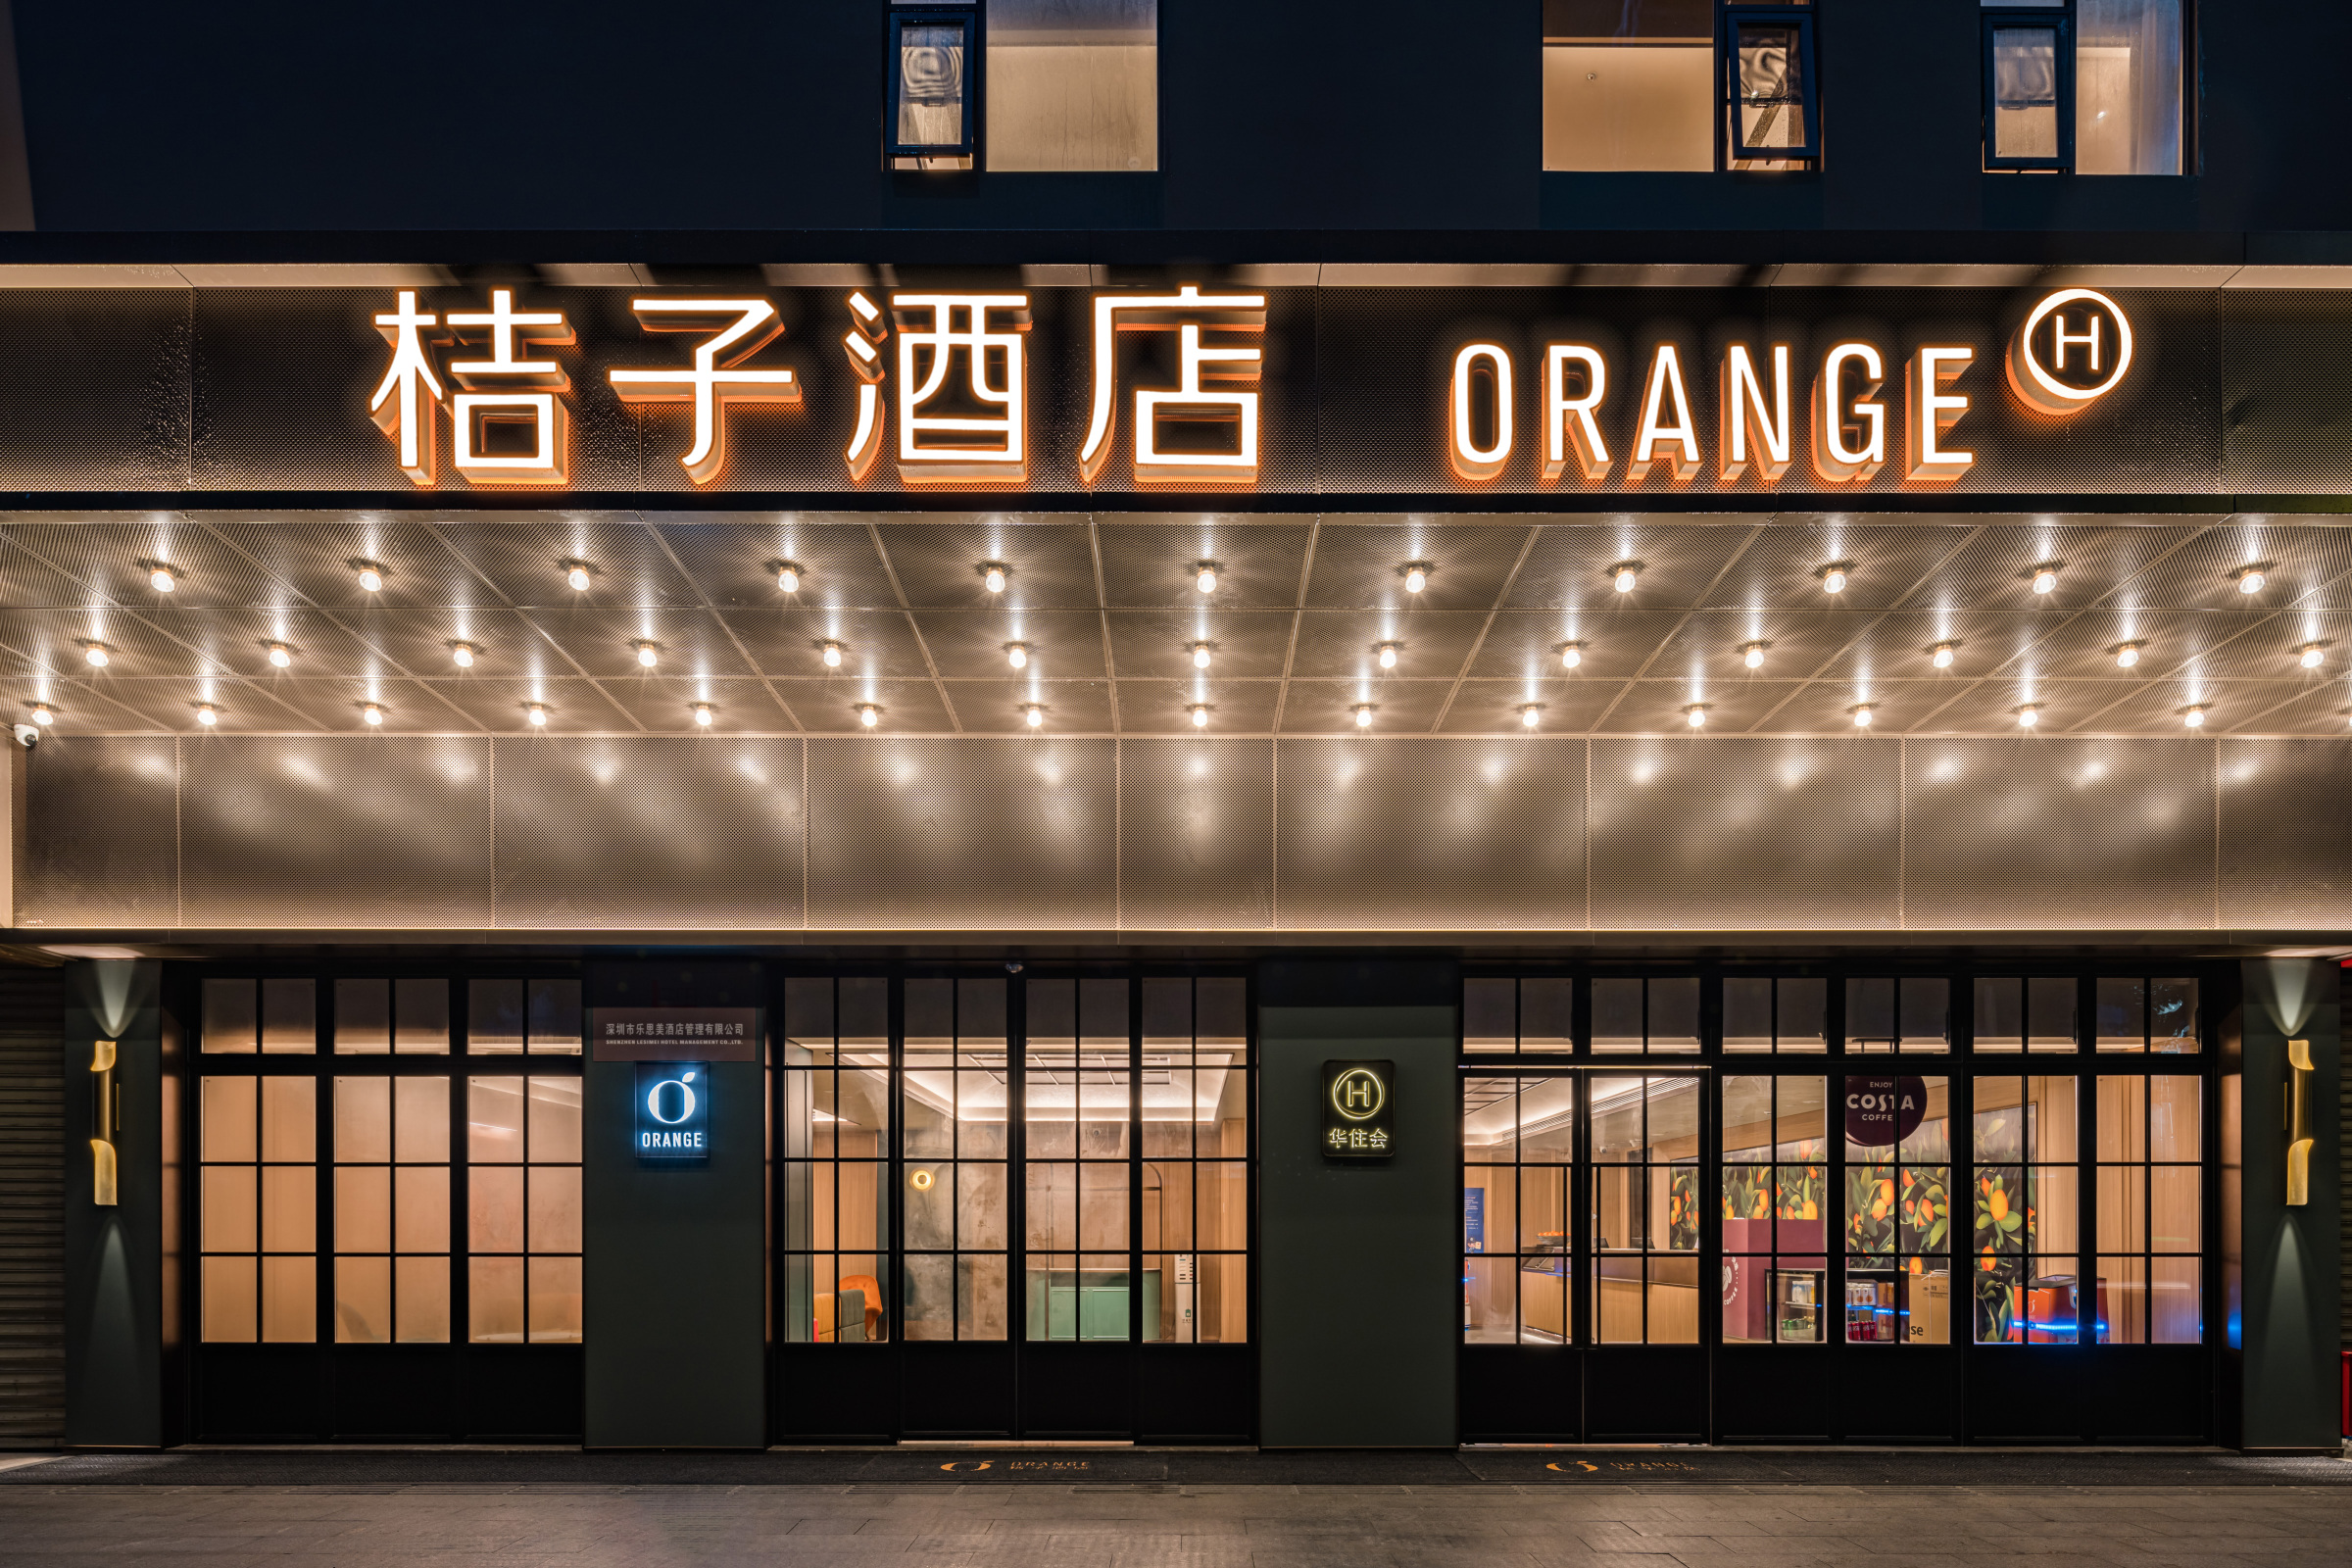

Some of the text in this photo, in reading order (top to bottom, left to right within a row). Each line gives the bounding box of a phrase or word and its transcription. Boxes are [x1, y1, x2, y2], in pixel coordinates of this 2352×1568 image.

[370, 285, 1266, 470] 桔子酒店
[1452, 343, 1974, 465] ORANGE
[606, 1023, 744, 1036] 深圳市乐思美酒店管理有限公司
[642, 1132, 703, 1148] ORANGE
[1329, 1128, 1388, 1149] 华住会
